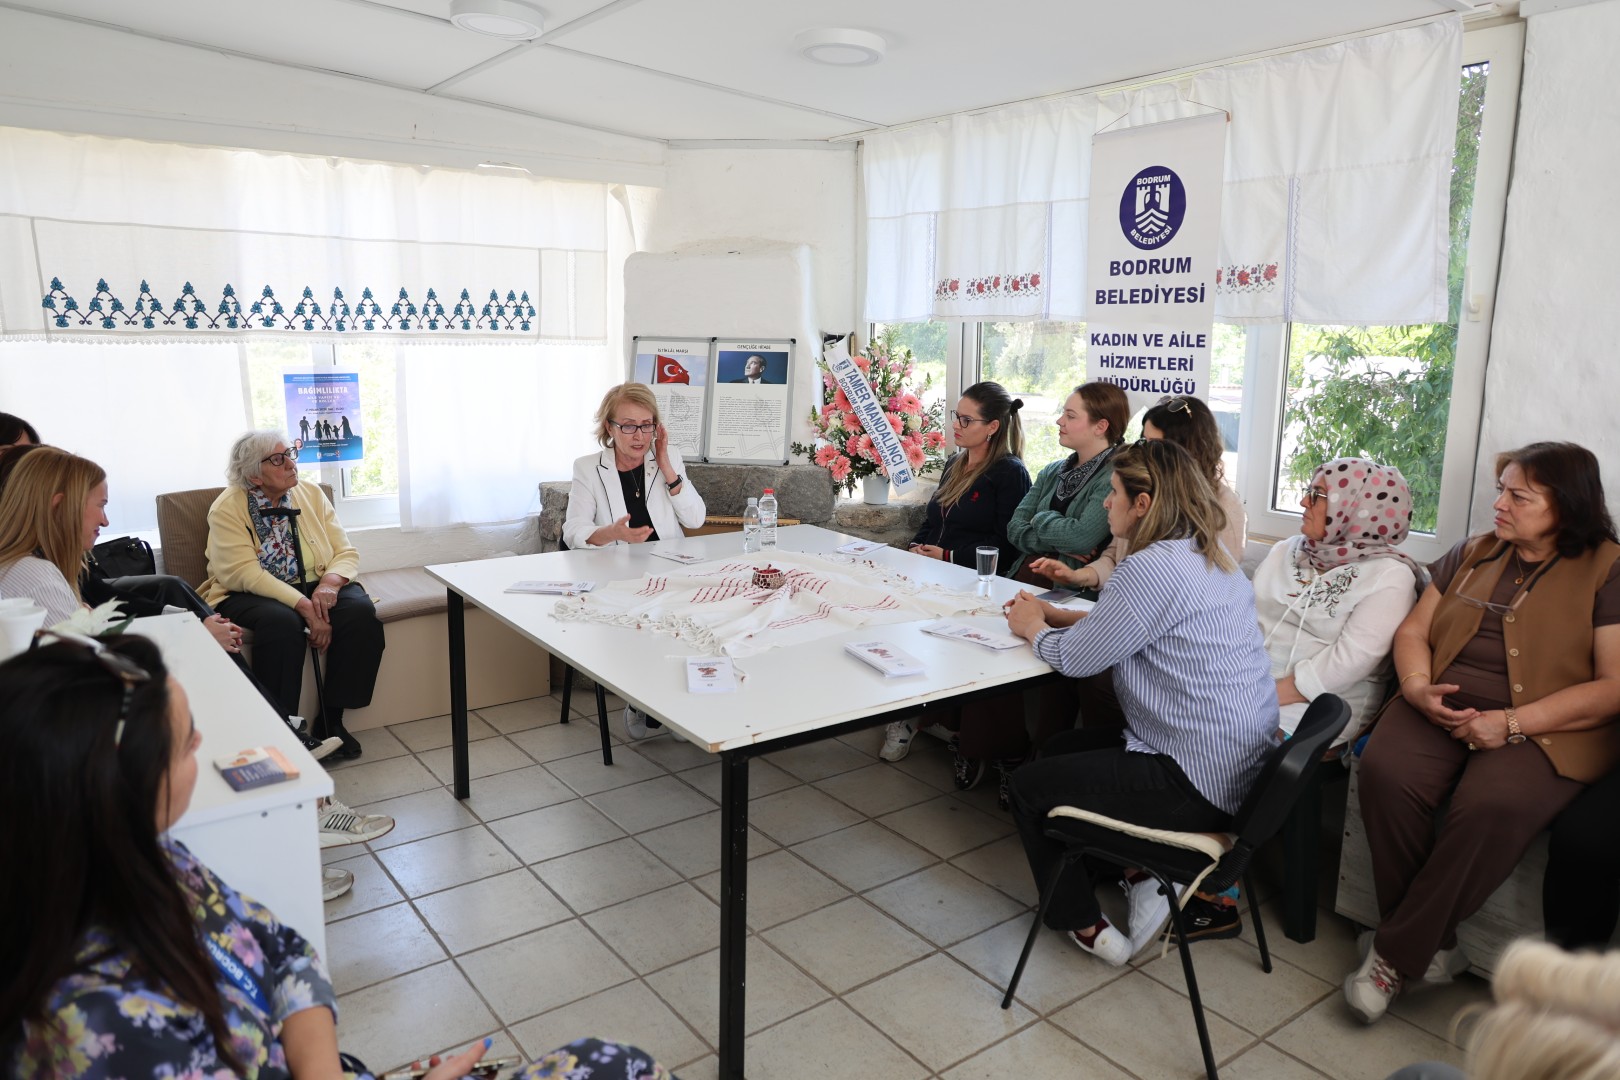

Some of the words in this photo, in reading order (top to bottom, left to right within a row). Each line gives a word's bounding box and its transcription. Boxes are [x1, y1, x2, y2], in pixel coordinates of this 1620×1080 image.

[1137, 175, 1171, 185] BODRUM
[1130, 225, 1173, 245] BELEDİYESİ
[1110, 257, 1192, 276] BODRUM
[1095, 283, 1205, 305] BELEDİYESİ
[1091, 333, 1137, 346] KADIN
[1143, 334, 1164, 347] VE
[1168, 331, 1206, 348] AİLE
[1100, 353, 1194, 371] HİZMETLERİ
[839, 378, 858, 405] BODRUM
[845, 368, 871, 403] TAMER
[863, 402, 907, 466] MANDALİNCİ
